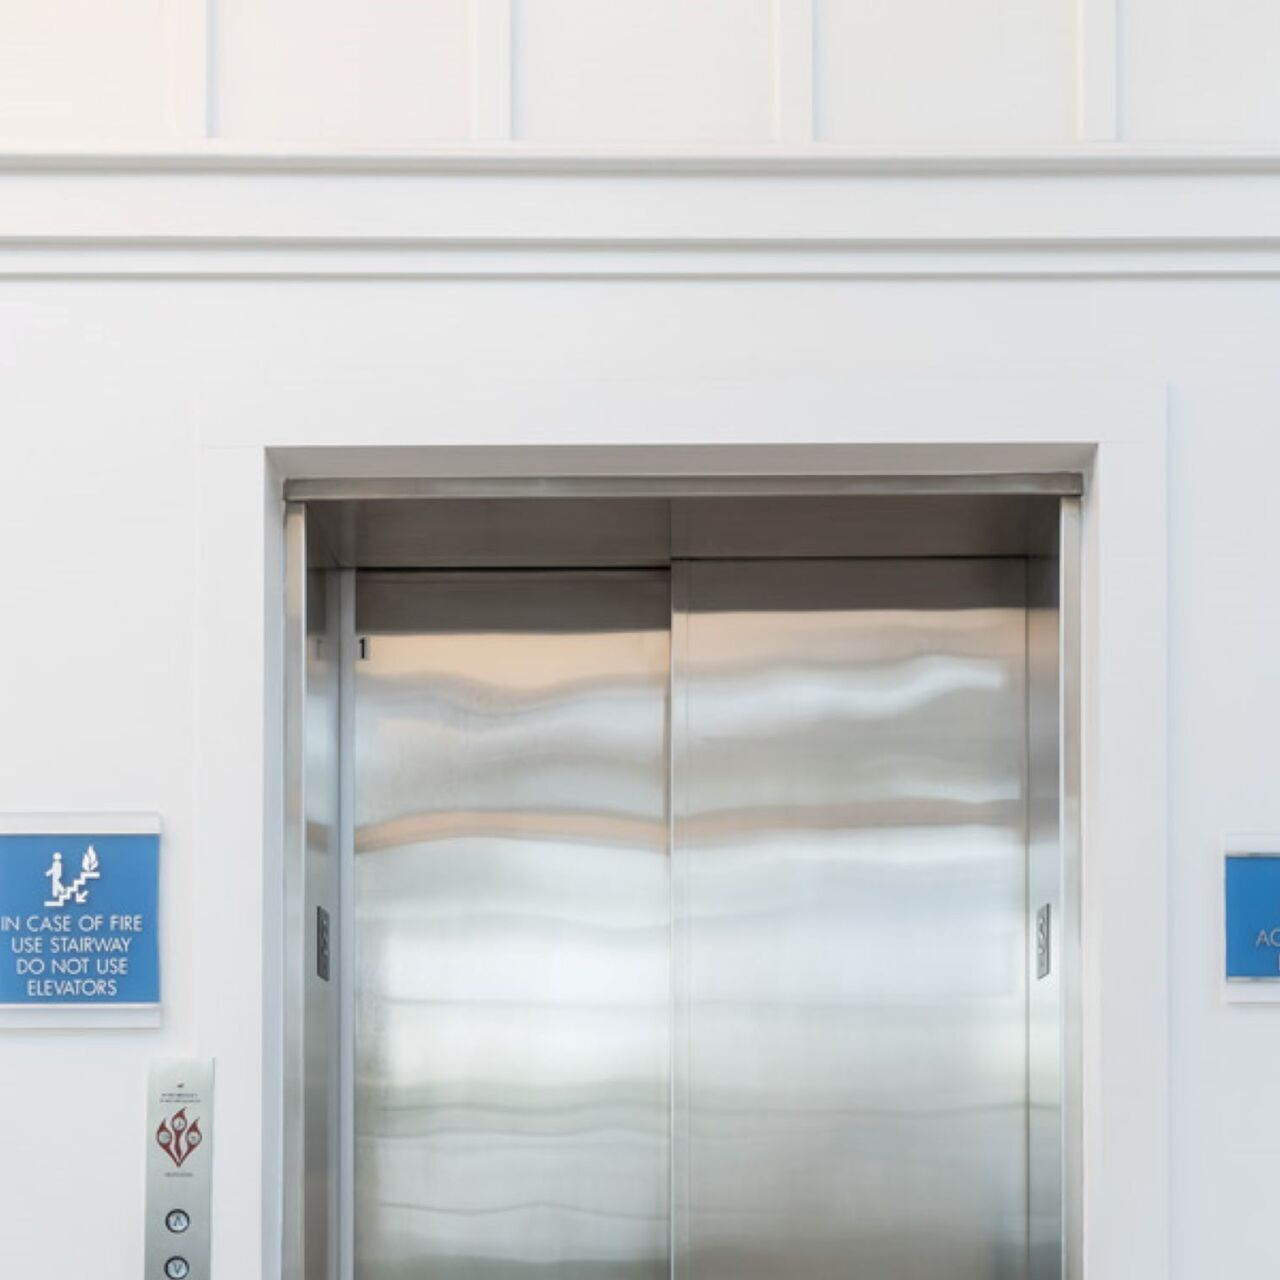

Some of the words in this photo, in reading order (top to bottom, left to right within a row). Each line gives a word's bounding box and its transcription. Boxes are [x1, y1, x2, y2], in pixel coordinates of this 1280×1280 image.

[359, 638, 365, 659] 1
[1, 915, 20, 932] IN
[26, 915, 72, 932] CASE
[79, 915, 104, 932] OF
[110, 915, 143, 932] FIRE
[12, 937, 43, 953] USE
[50, 937, 132, 953] STAIRWAY
[16, 958, 45, 975] DO
[52, 958, 90, 975] NOT
[98, 958, 128, 975] USE
[27, 979, 117, 996] ELEVATORS
